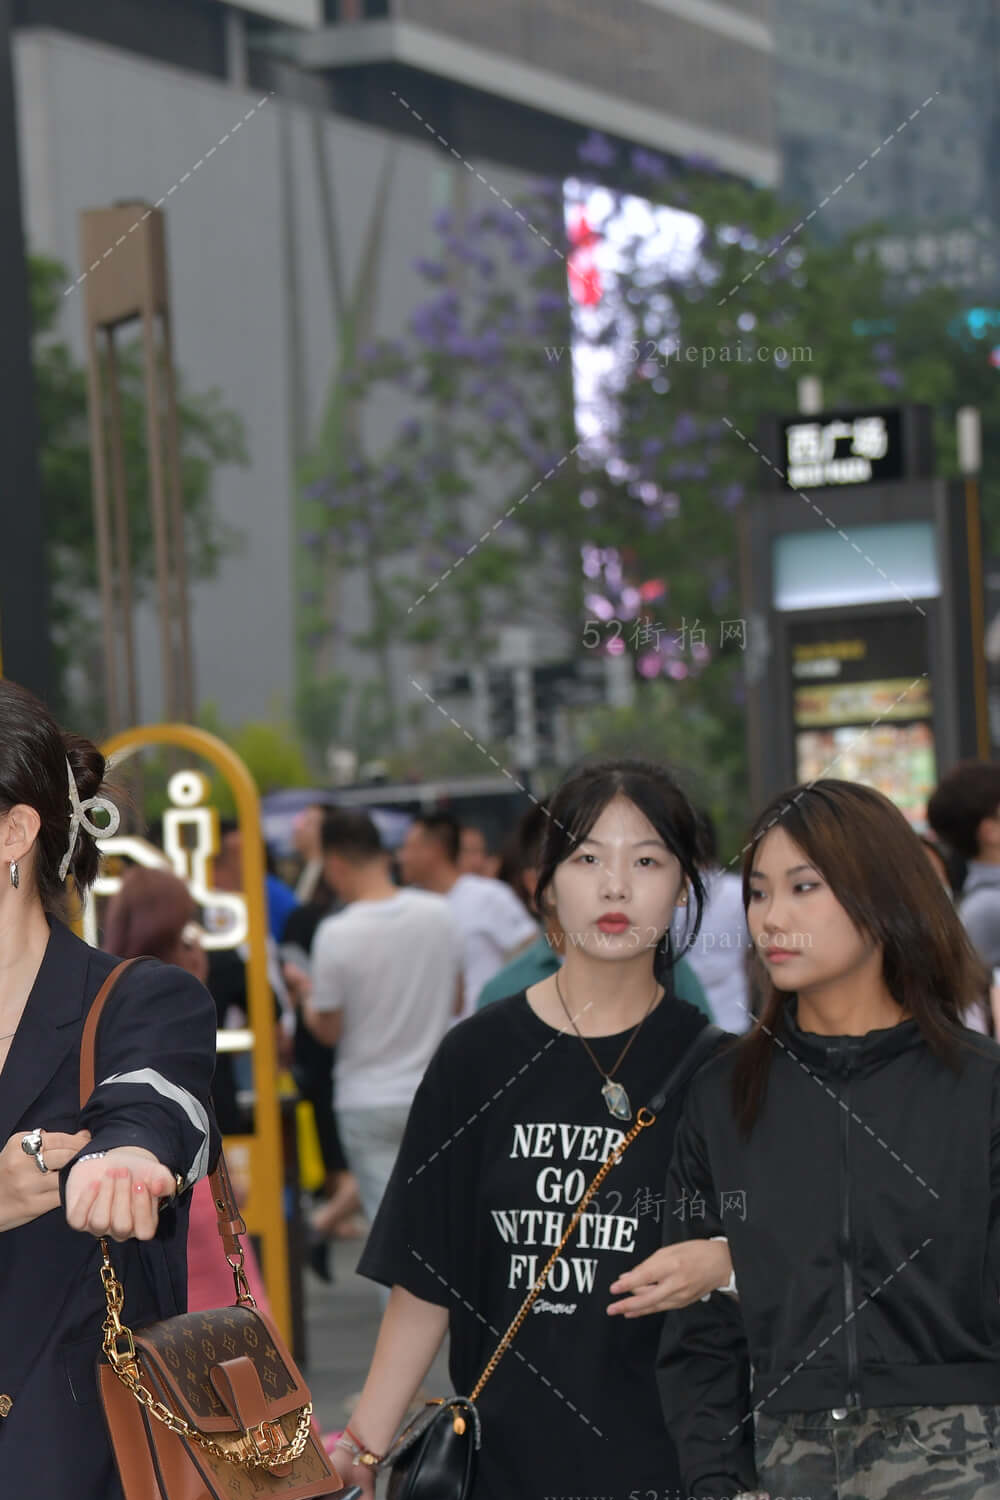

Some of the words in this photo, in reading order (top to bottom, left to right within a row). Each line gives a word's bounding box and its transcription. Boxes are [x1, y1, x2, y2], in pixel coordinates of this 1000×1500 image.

[509, 1123, 626, 1165] NEVER
[536, 1166, 586, 1205] GO
[572, 1212, 639, 1253] THE
[507, 1253, 598, 1294] FLOW
